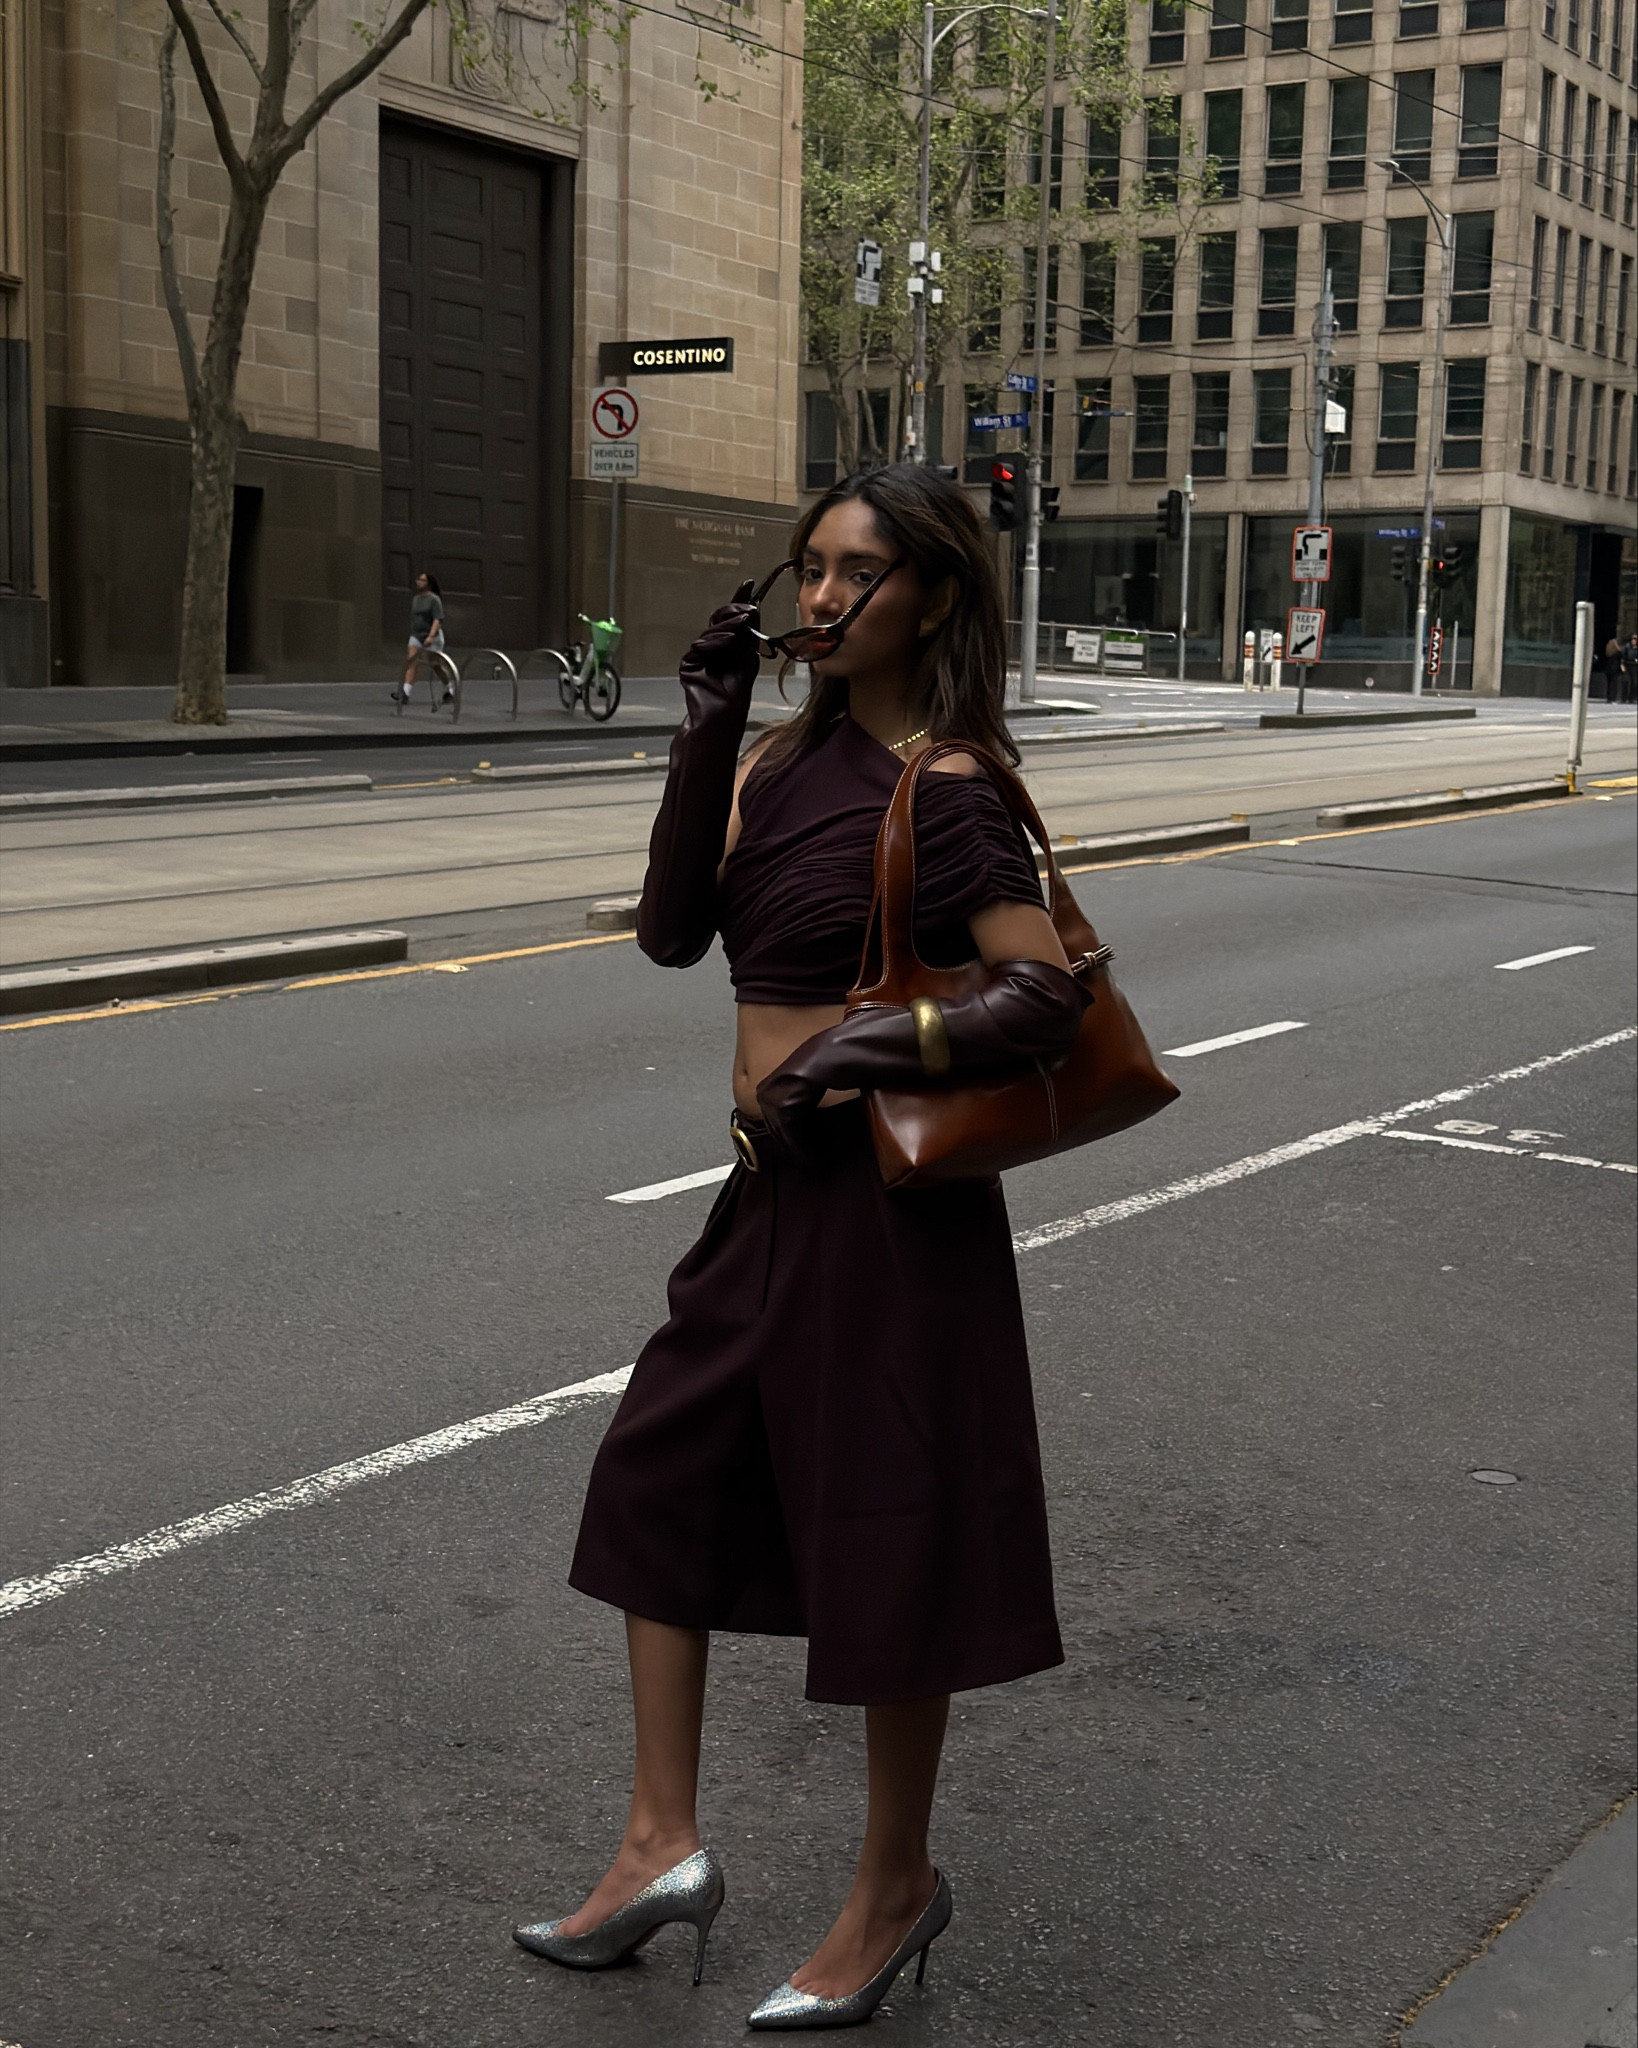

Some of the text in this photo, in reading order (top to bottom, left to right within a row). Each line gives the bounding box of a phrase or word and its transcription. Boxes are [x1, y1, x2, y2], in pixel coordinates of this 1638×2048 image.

[633, 347, 726, 366] COSENTINO
[594, 448, 634, 458] VEHICLES
[1296, 615, 1318, 624] KEEP
[1295, 624, 1315, 633] LEFT
